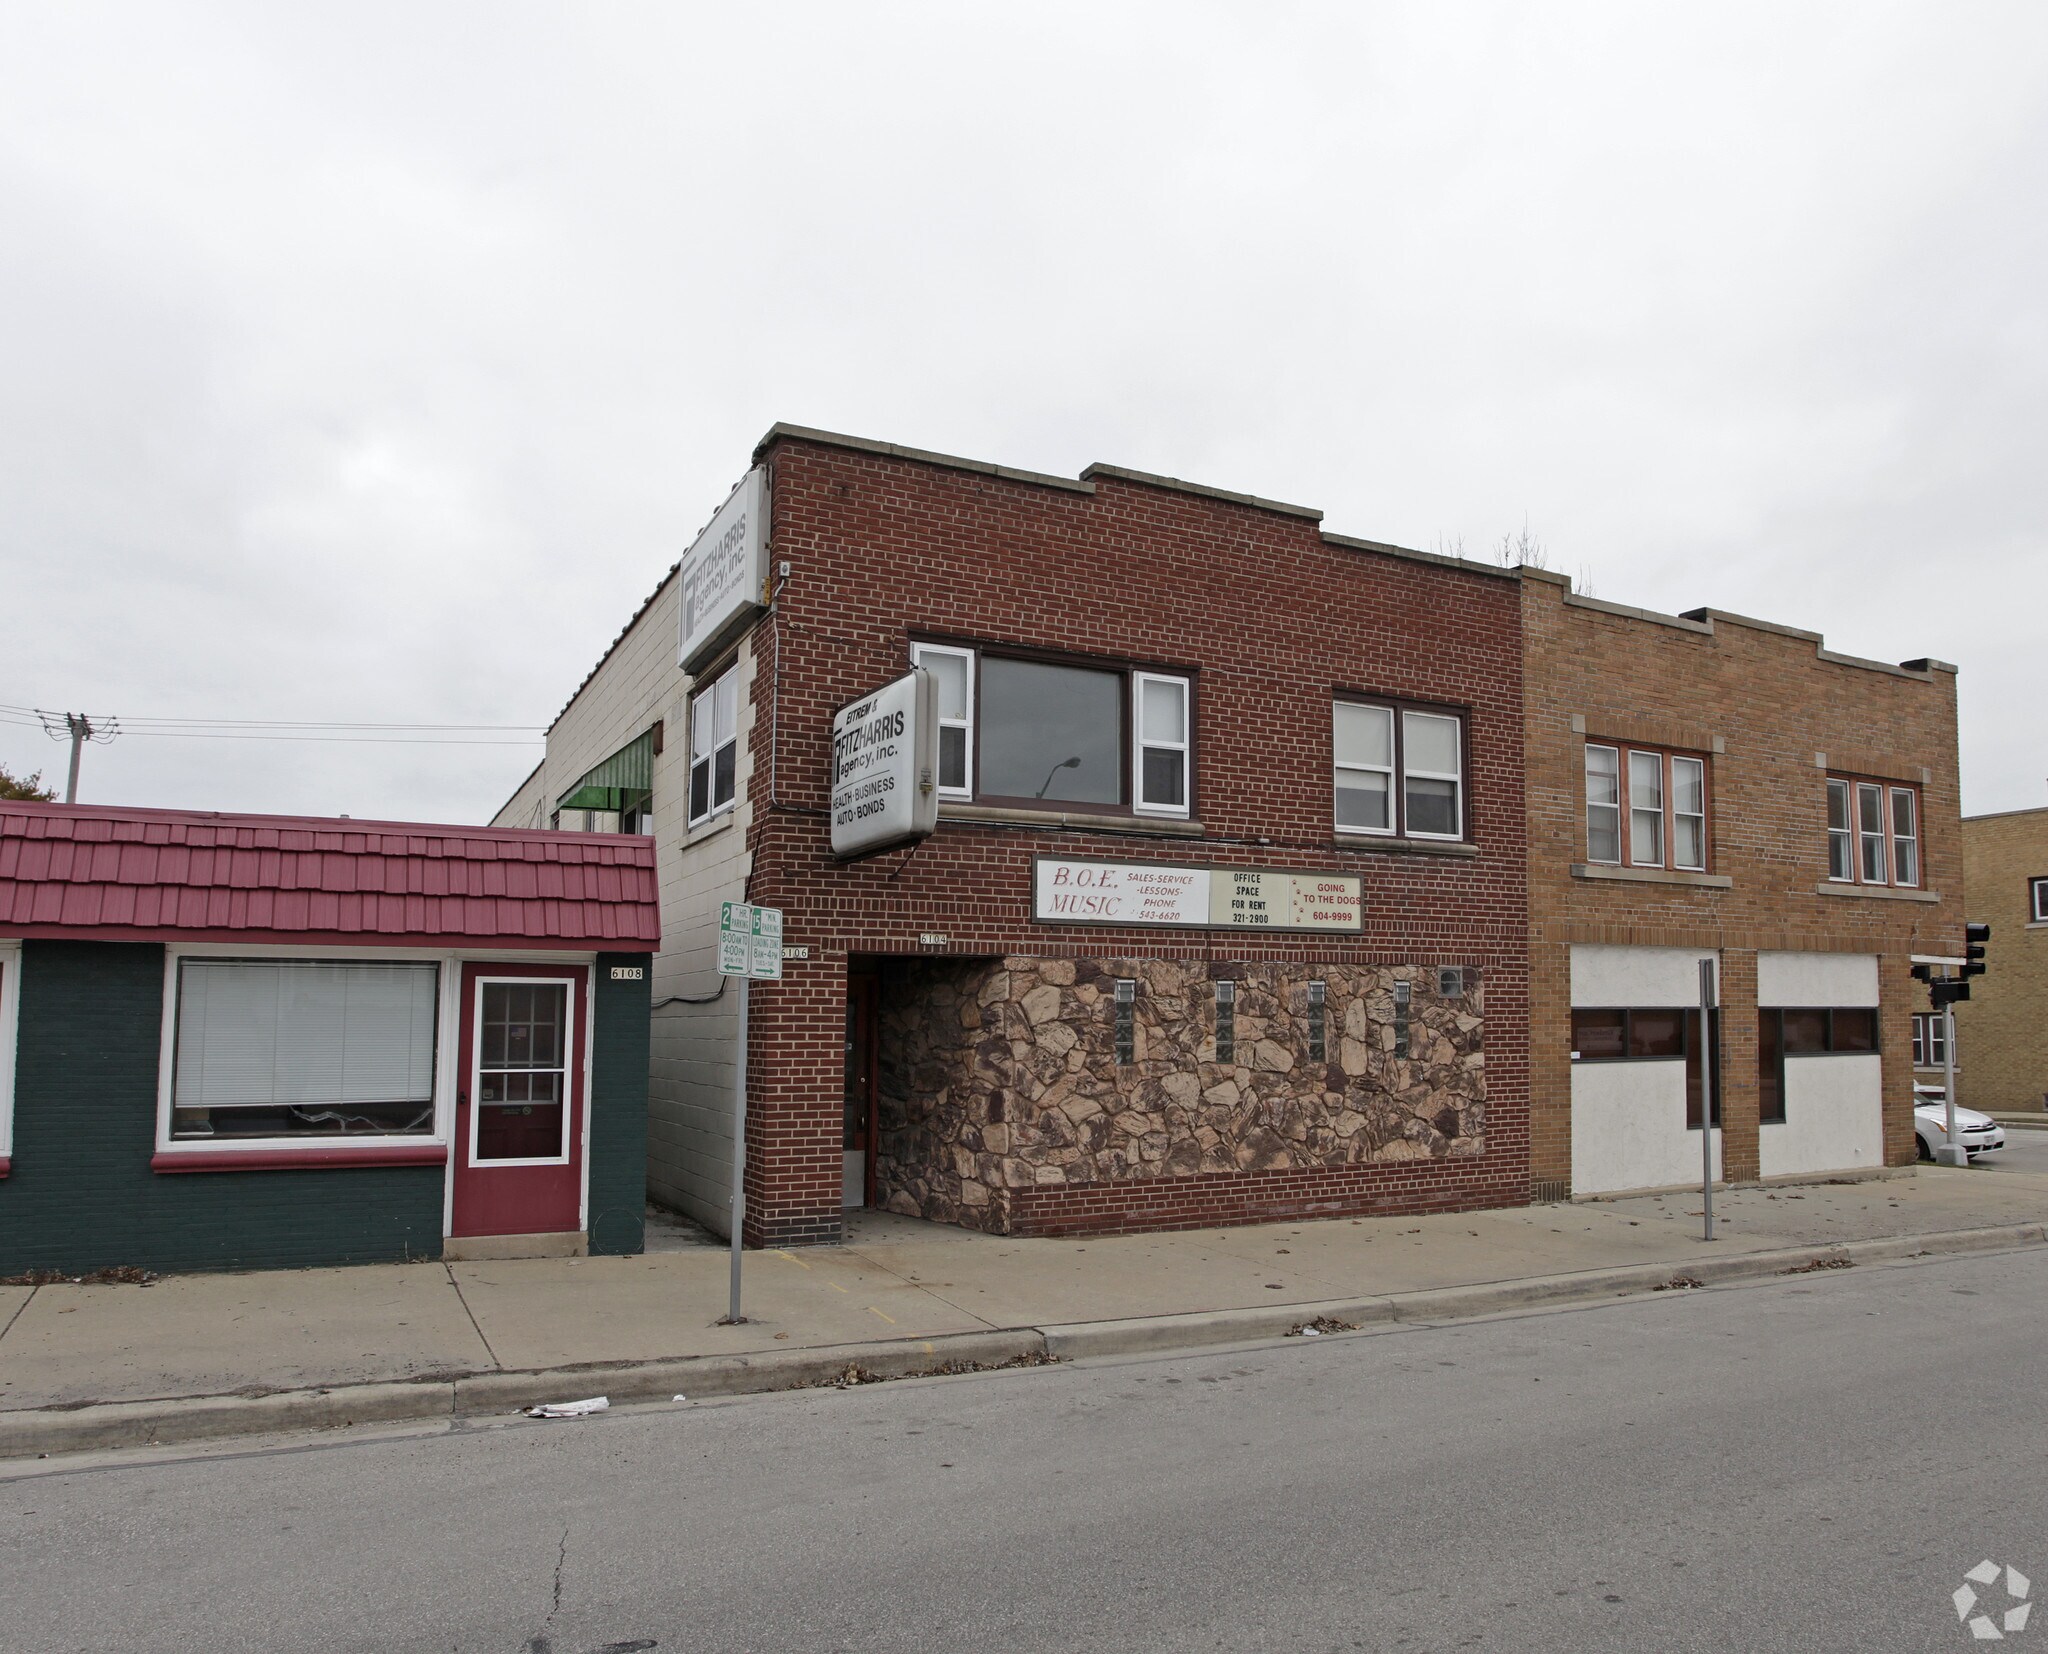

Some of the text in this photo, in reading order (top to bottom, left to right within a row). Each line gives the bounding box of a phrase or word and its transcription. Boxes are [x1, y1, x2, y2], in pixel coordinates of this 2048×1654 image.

[695, 513, 746, 592] FITZHARRIS
[840, 711, 904, 759] FITZHARRIS
[876, 744, 898, 761] inc.
[1233, 873, 1261, 883] OFFICE
[1236, 886, 1259, 896] SPACE
[1317, 883, 1345, 893] GOING
[1049, 894, 1122, 916] MUSIC
[1143, 898, 1177, 908] PHONE
[1231, 899, 1266, 911] FOR RENT
[1303, 894, 1361, 905] TO THE DOGS
[722, 907, 730, 925] 2
[1138, 910, 1181, 921] 543-6620
[1233, 913, 1269, 924] 321-2900
[1313, 911, 1353, 921] 604-9999
[731, 918, 749, 930] PARKING
[921, 934, 946, 943] 6104
[612, 969, 641, 978] 6108
